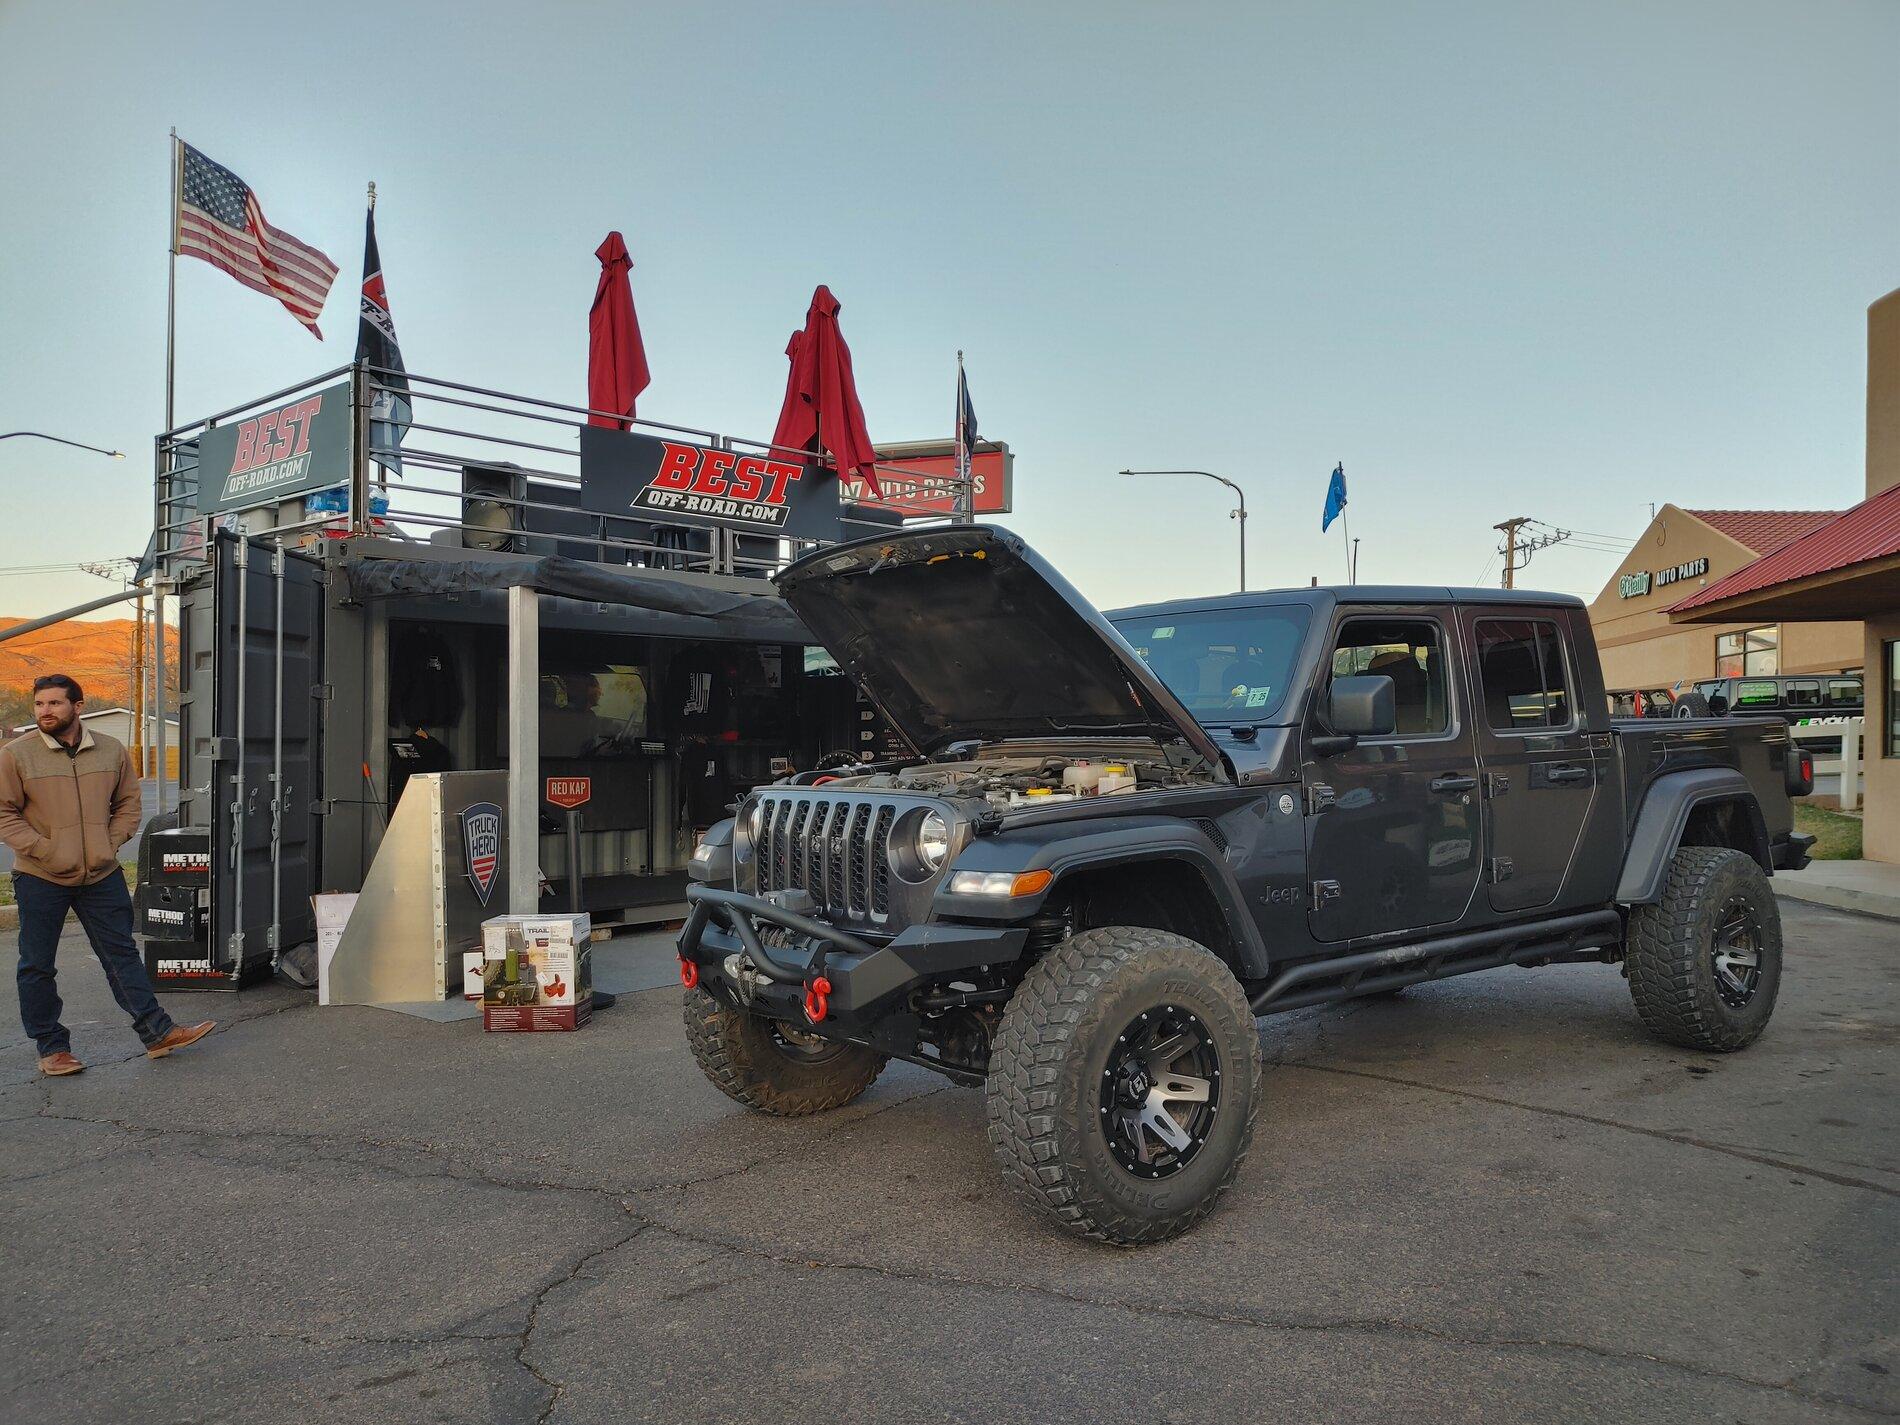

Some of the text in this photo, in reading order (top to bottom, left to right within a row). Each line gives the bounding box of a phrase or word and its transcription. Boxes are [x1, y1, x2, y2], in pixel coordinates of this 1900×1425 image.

[230, 394, 323, 475] BEST
[228, 458, 304, 493] OFF-ROAD.COM
[648, 441, 804, 505] BEST
[923, 475, 986, 497] PAS
[646, 490, 780, 522] OFF-ROAD.COM
[1620, 557, 1708, 599] O'Reilly AUTO PARTS
[551, 781, 586, 795] RED KAP
[468, 817, 497, 838] TRUCK
[471, 837, 496, 858] HERO
[163, 854, 210, 863] METH
[1259, 885, 1300, 905] Jeep
[148, 908, 184, 921] METHOD
